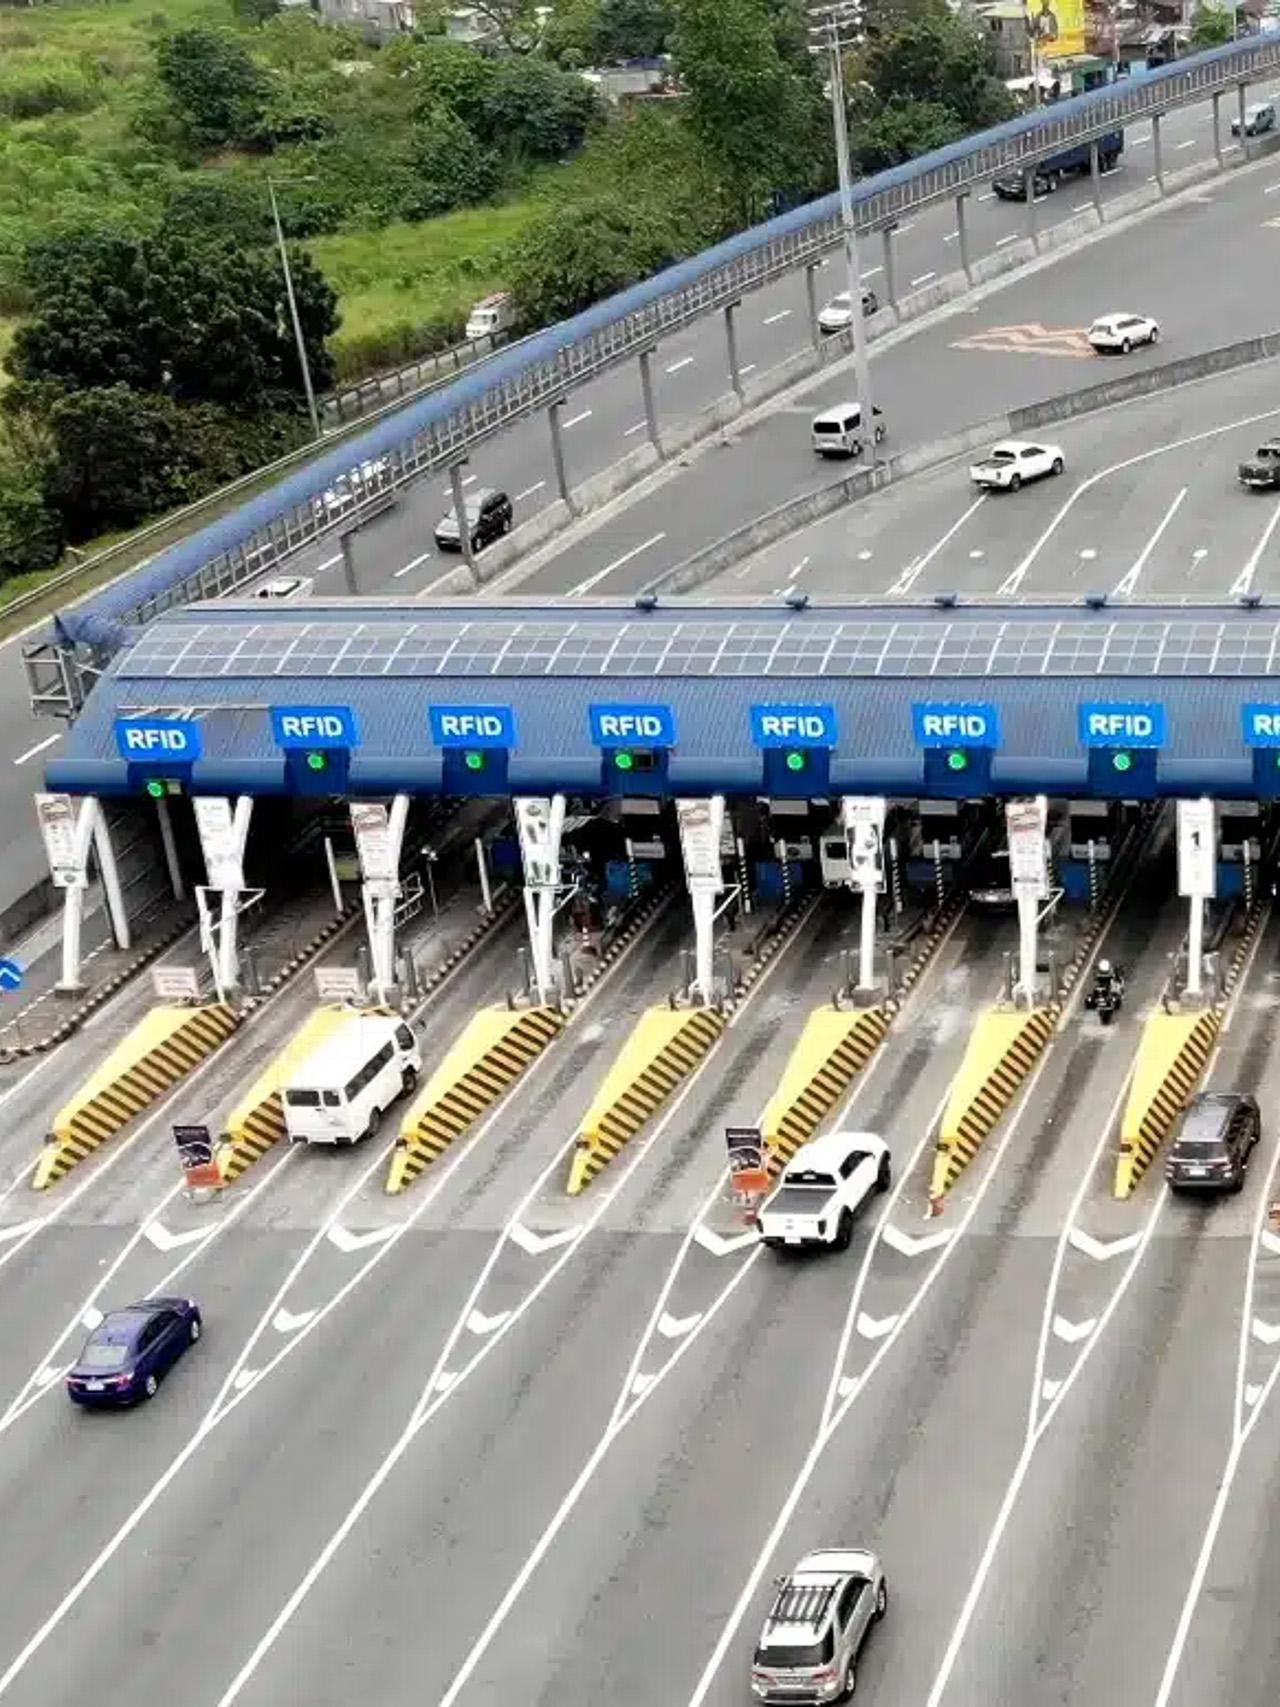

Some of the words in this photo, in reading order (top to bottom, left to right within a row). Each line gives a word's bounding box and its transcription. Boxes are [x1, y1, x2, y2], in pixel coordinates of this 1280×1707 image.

[282, 716, 343, 737] RFID
[441, 715, 503, 736] RFID
[600, 715, 662, 737] RFID
[761, 716, 824, 738] RFID
[923, 715, 986, 736] RFID
[1089, 714, 1152, 737] RFID
[125, 727, 188, 751] RFID
